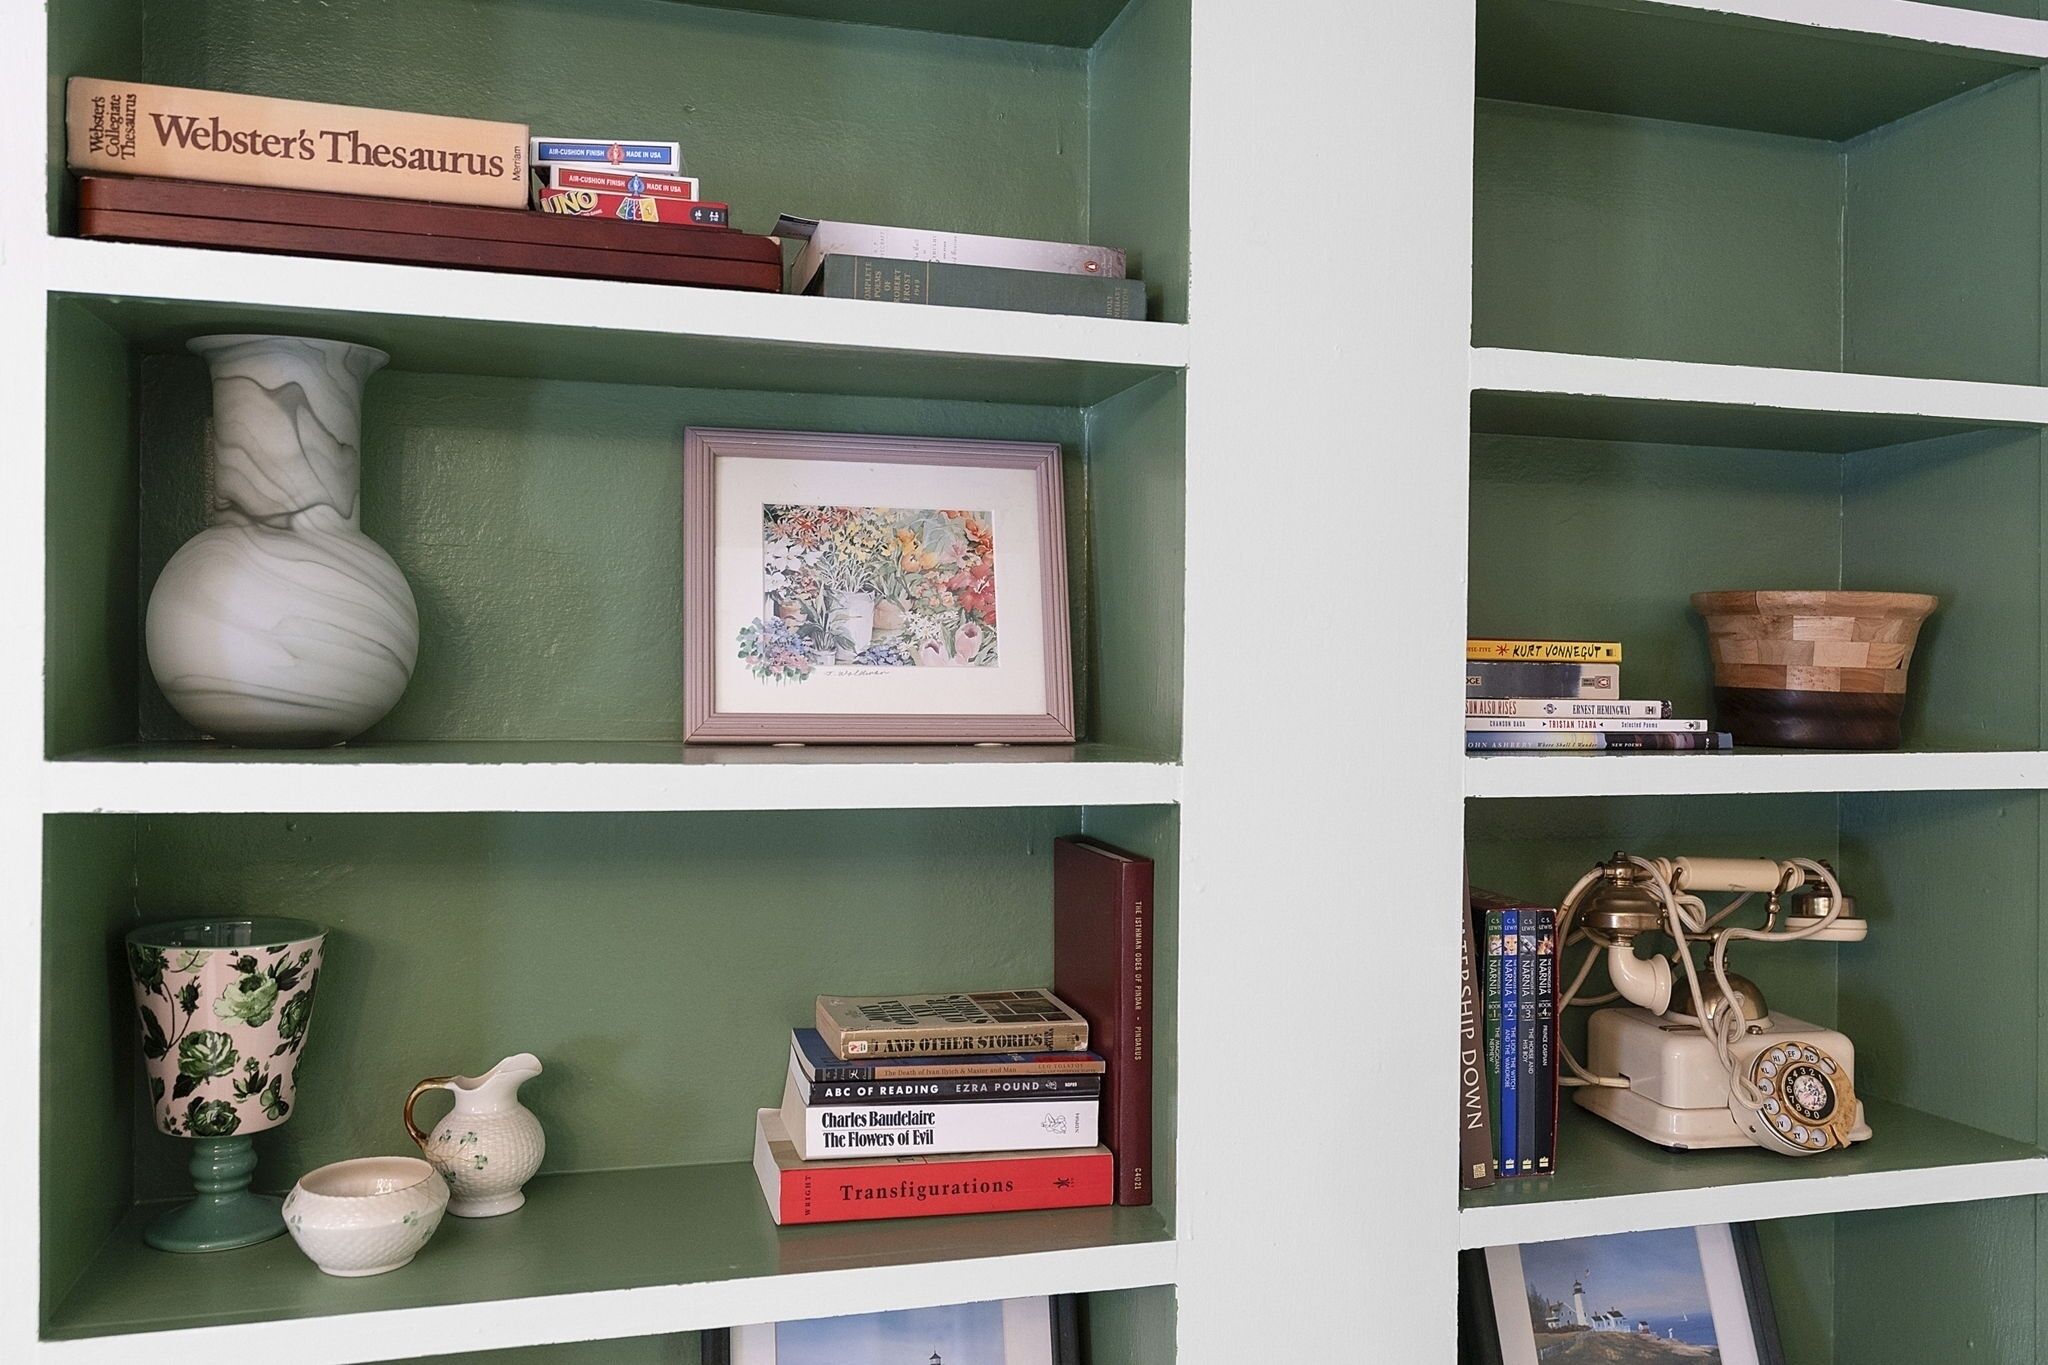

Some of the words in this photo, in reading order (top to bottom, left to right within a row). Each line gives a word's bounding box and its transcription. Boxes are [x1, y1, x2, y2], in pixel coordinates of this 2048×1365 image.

[89, 95, 106, 153] Webster's
[106, 94, 123, 157] Collegiate
[121, 93, 137, 160] Thesaurus
[148, 111, 316, 160] Webster's
[319, 129, 505, 178] Thesaurus
[549, 148, 585, 156] AIR-CUSHION
[586, 149, 605, 157] FINISH
[511, 145, 522, 181] Merriam
[568, 175, 606, 185] AIR-CUSHION
[606, 178, 626, 187] FINISH
[646, 183, 663, 191] MADE
[540, 190, 599, 215] UNO
[864, 261, 872, 300] OMPLETE
[874, 270, 882, 298] POEMS
[884, 280, 891, 291] OF
[903, 272, 911, 302] FROST
[1513, 644, 1542, 657] KURT
[1545, 643, 1602, 660] VONNEGUT
[1465, 701, 1478, 714] SUN
[1480, 701, 1496, 714] ALSO
[1497, 701, 1517, 715] RISES
[1572, 704, 1595, 715] ERNEST
[1596, 704, 1631, 716] HEMINGWAY
[1549, 720, 1575, 729] TRISTAN
[1578, 720, 1597, 729] TZARA
[1135, 973, 1142, 983] OF
[1489, 959, 1498, 997] NARNIA
[1504, 959, 1513, 997] NARNIA
[1522, 960, 1531, 997] NARNIA
[1539, 958, 1548, 996] NARNIA
[1134, 985, 1142, 1010] PINDAR
[1507, 1008, 1513, 1017] 2
[1525, 1010, 1531, 1019] 3
[1542, 1008, 1547, 1017] 4
[884, 1038, 916, 1053] AND
[919, 1036, 974, 1051] OTHER
[977, 1032, 1043, 1049] STORIES
[1134, 1026, 1142, 1061] PINDARUS
[1792, 1069, 1798, 1077] 4
[1800, 1067, 1806, 1075] 3
[1809, 1068, 1815, 1076] 2
[1818, 1074, 1823, 1082] 1
[825, 1087, 851, 1097] ABC
[857, 1086, 874, 1096] OF
[880, 1084, 939, 1095] READING
[956, 1082, 988, 1093] EZRA
[994, 1081, 1040, 1092] POUND
[1461, 1048, 1484, 1130] DOWN
[1786, 1085, 1793, 1093] 6
[1787, 1076, 1793, 1085] 5
[1789, 1095, 1795, 1104] 7
[1795, 1103, 1802, 1112] 8
[822, 1111, 867, 1129] Charles
[869, 1110, 936, 1127] Baudelaire
[1804, 1109, 1811, 1117] 9
[1813, 1111, 1820, 1119] 0
[823, 1131, 846, 1148] The
[848, 1131, 895, 1148] Flowers
[897, 1129, 910, 1143] of
[912, 1129, 934, 1146] Evil
[839, 1177, 1014, 1202] Transfigurations
